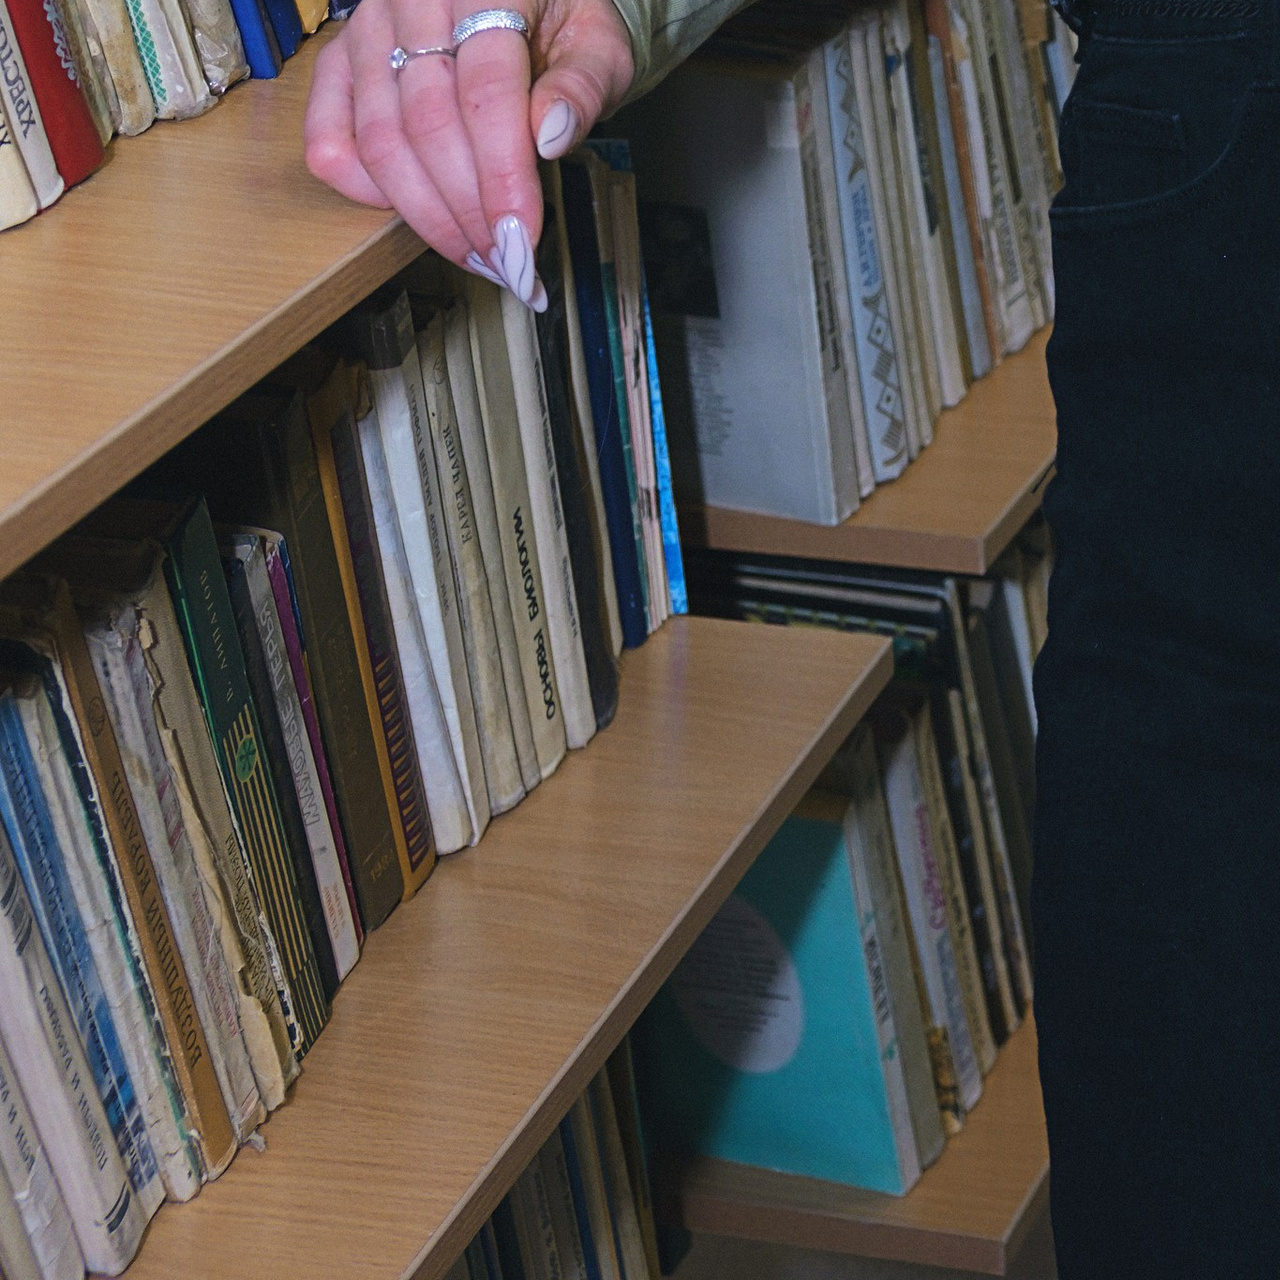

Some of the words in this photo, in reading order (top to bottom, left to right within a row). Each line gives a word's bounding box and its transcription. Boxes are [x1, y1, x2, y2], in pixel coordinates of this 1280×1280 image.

[0, 26, 38, 138] ХРЕСТО
[407, 382, 423, 443] ГОФМАН
[442, 422, 461, 484] ЧАПЕК
[454, 486, 471, 544] КАРЕЛ
[511, 505, 539, 621] БИОЛОГИИ
[258, 601, 287, 691] ПЕРЬЯ
[532, 626, 556, 720] ОСНОВЫ
[278, 696, 320, 826] МАХОВЫЕ
[108, 770, 152, 896] КОРАБЛЬ
[144, 895, 204, 1068] ВОЗДУШНЫЙ
